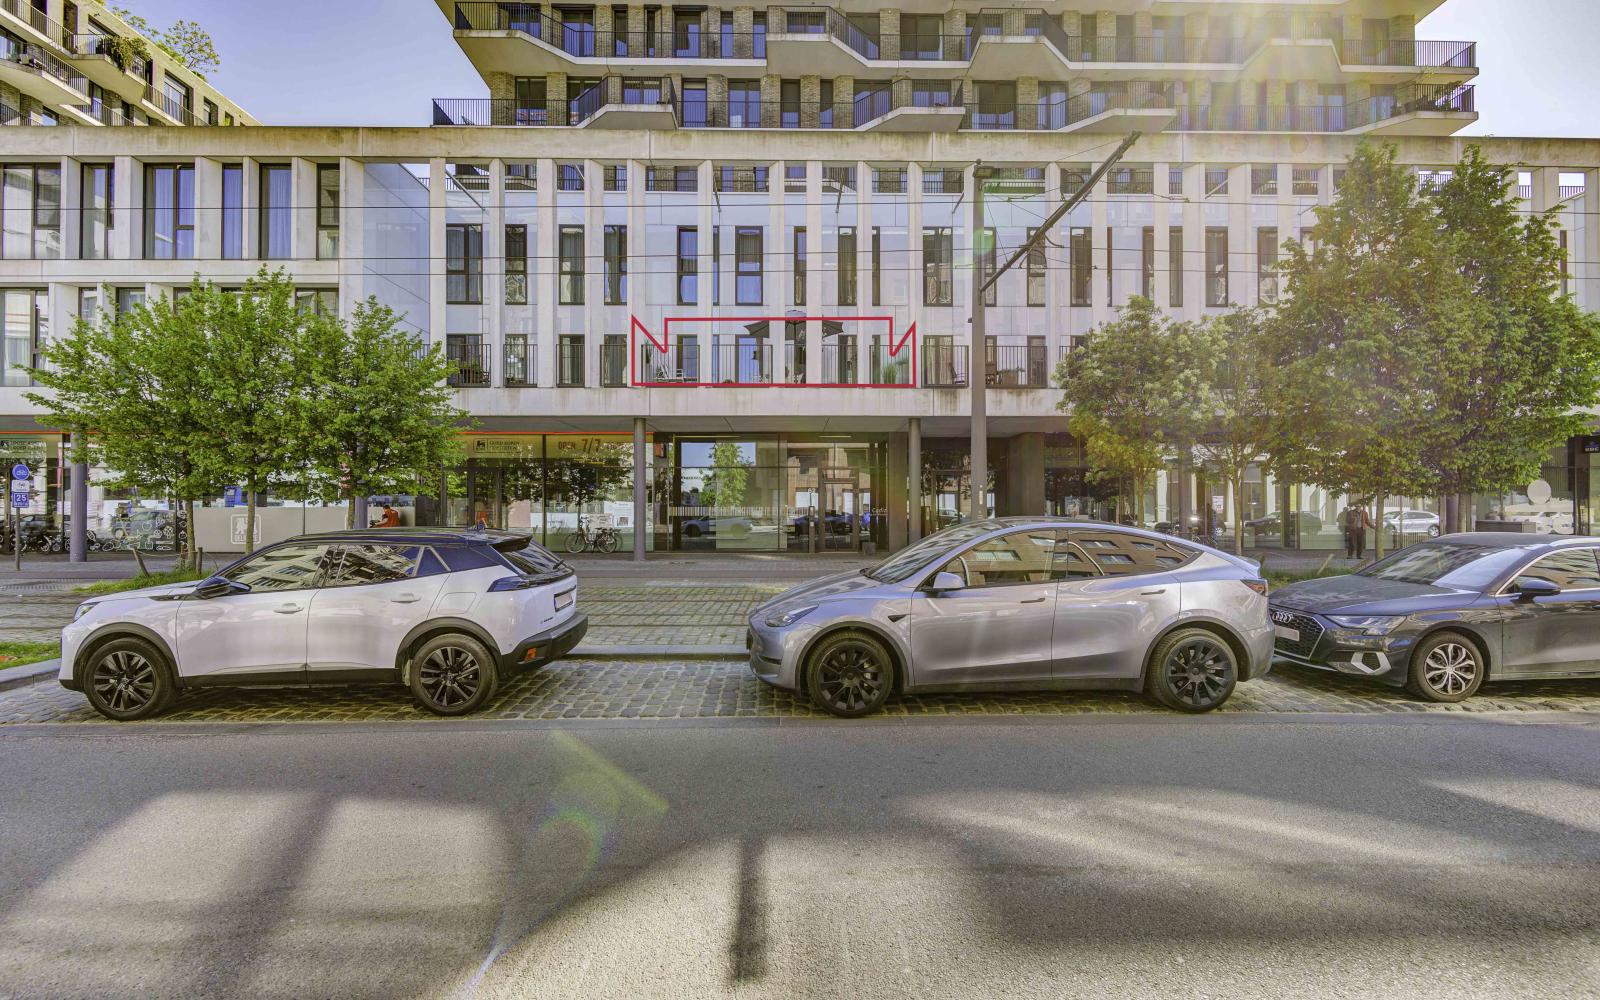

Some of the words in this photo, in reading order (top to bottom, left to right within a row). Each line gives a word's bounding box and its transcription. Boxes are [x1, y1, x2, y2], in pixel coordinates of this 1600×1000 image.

[558, 441, 576, 450] OPEN
[582, 437, 602, 454] 7/7
[16, 494, 27, 502] 25
